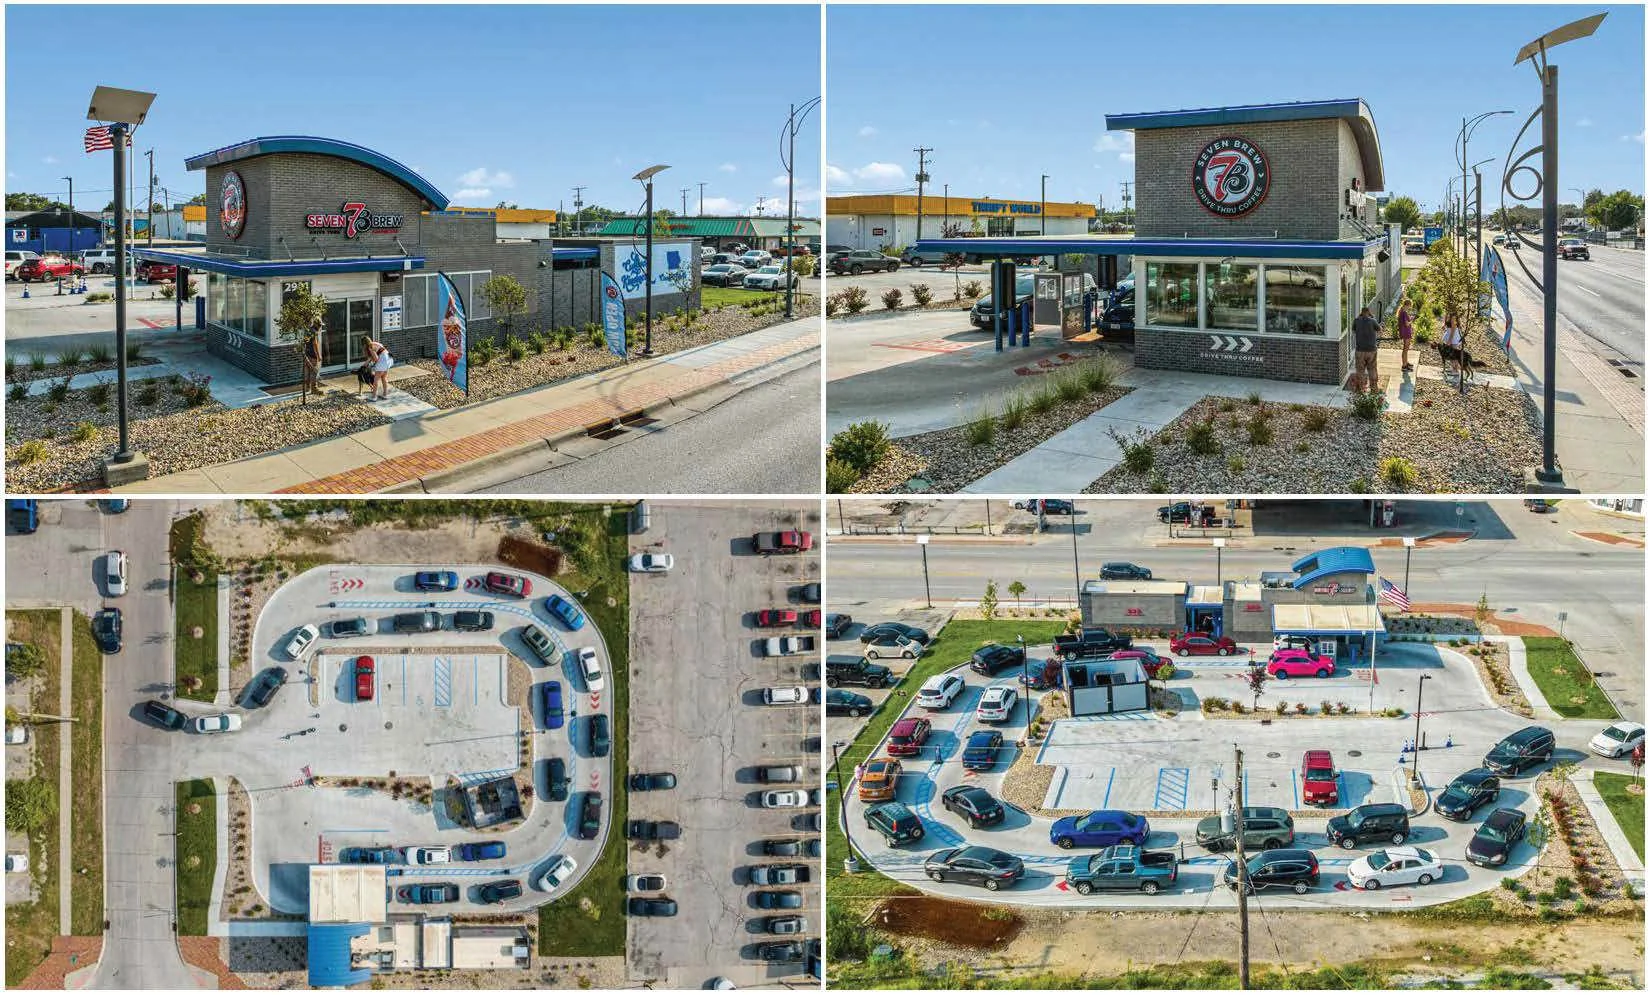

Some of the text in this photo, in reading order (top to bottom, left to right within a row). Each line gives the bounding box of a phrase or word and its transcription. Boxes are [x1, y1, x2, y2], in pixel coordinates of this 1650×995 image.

[1198, 140, 1262, 167] SEVEN BREW
[972, 201, 1041, 215] THRIFT WORLD
[1198, 186, 1262, 214] DRIVE THRU COFFEE
[307, 214, 346, 228] SEVEN
[372, 215, 404, 228] BREW
[284, 281, 310, 292] 291
[606, 302, 618, 329] OPEN
